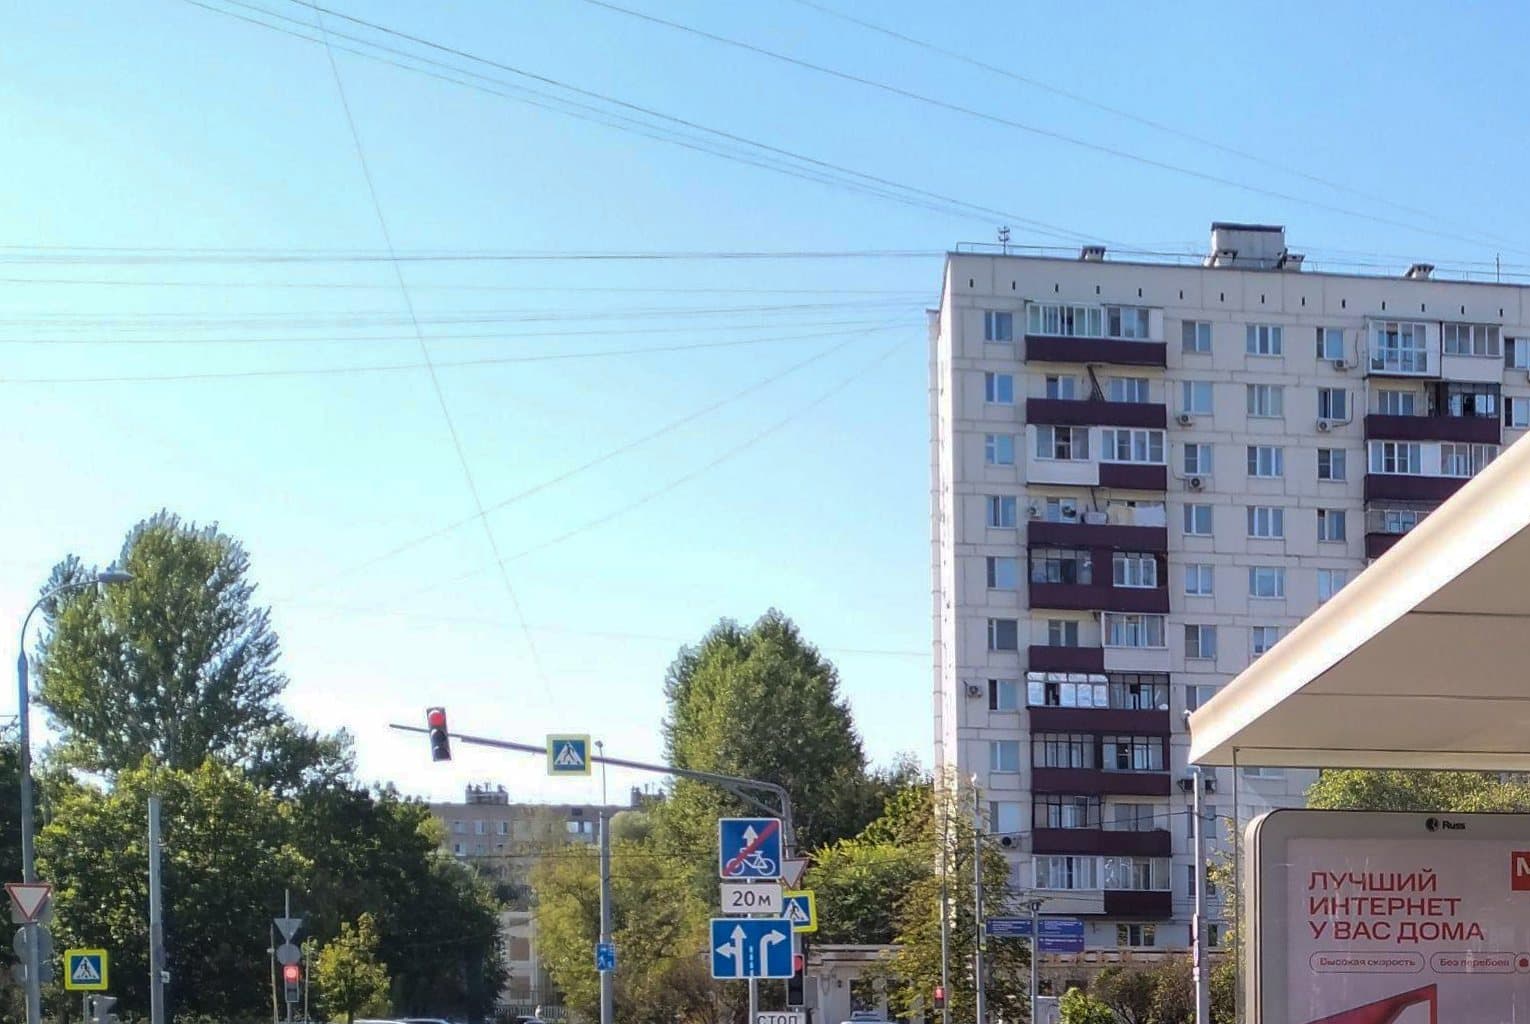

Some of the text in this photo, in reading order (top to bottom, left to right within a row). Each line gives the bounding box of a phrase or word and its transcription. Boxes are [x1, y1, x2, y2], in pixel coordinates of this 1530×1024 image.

[1442, 820, 1466, 830] Russ
[1308, 868, 1437, 892] ЛУЧШИЙ
[732, 890, 755, 907] 20
[1309, 898, 1461, 917] ИНТЕРНЕТ
[1308, 921, 1484, 943] У ВАС ДОМА
